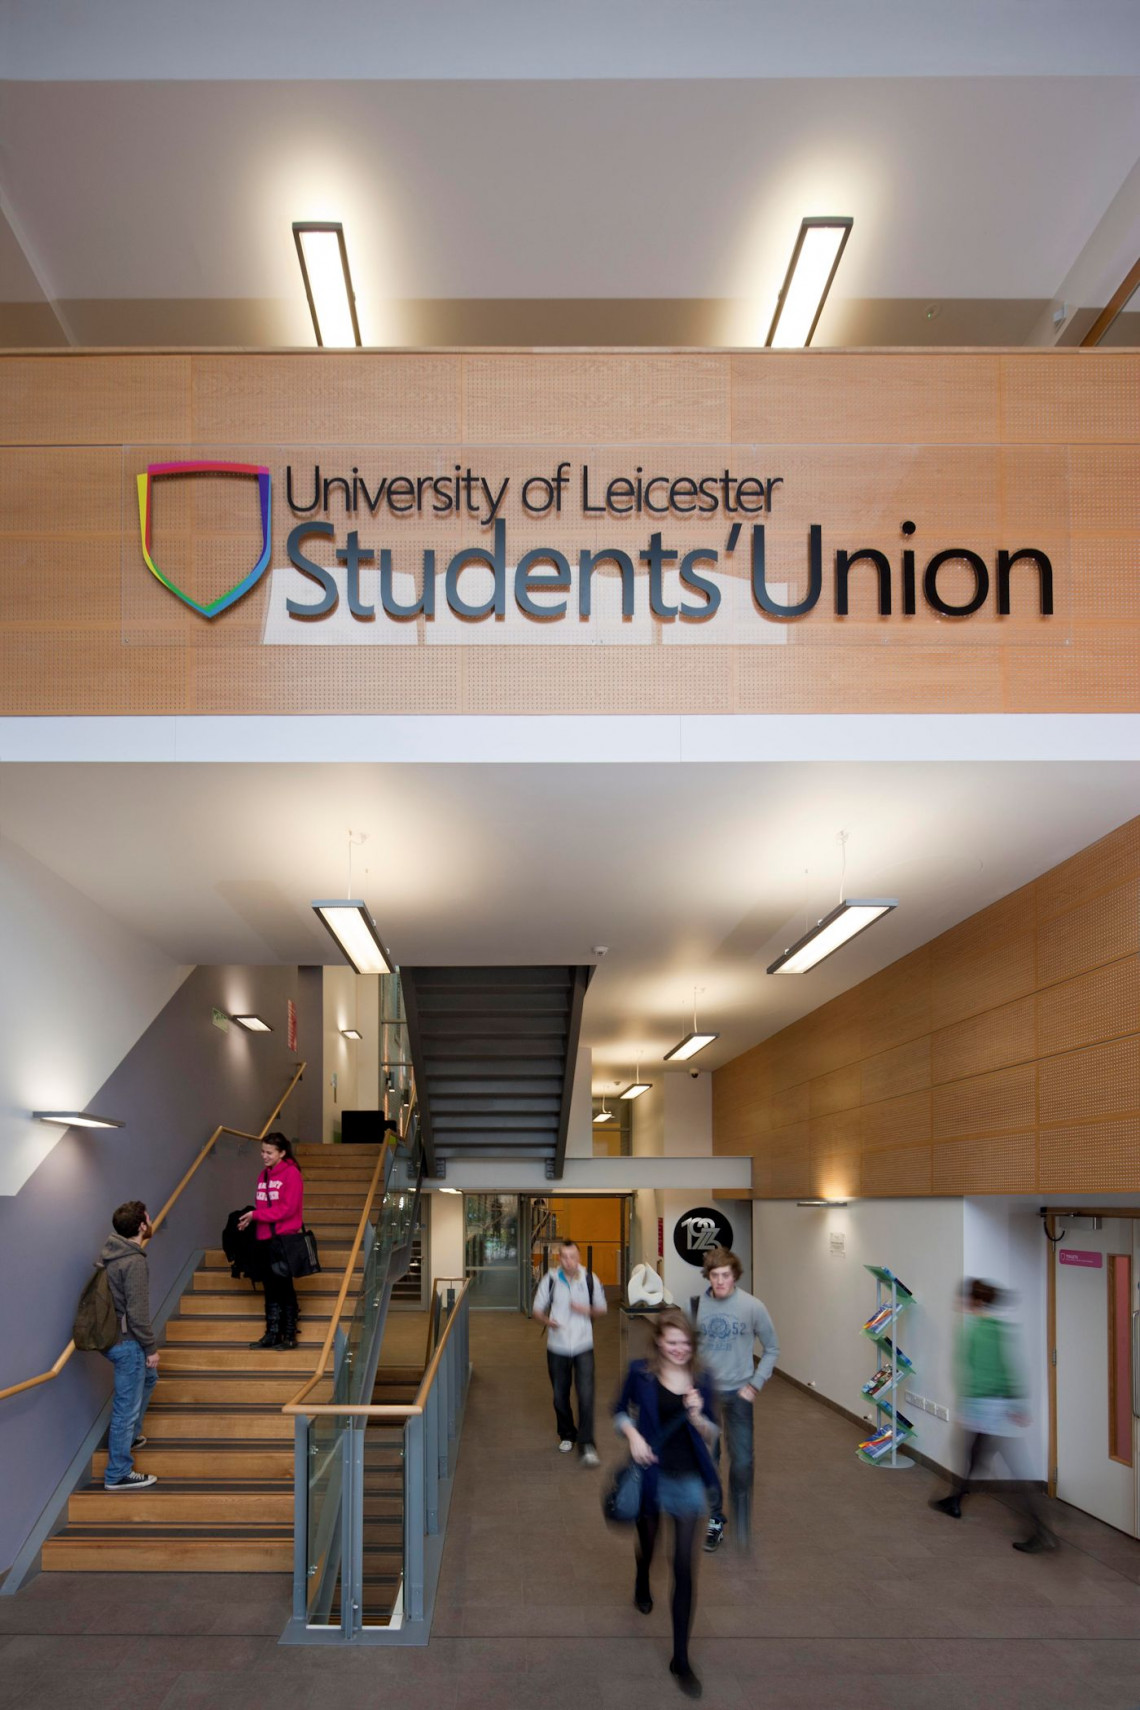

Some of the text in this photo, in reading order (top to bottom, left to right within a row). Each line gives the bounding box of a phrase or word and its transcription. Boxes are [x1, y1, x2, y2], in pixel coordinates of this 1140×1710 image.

[286, 462, 784, 525] University of Leicester
[752, 520, 1054, 617] Union
